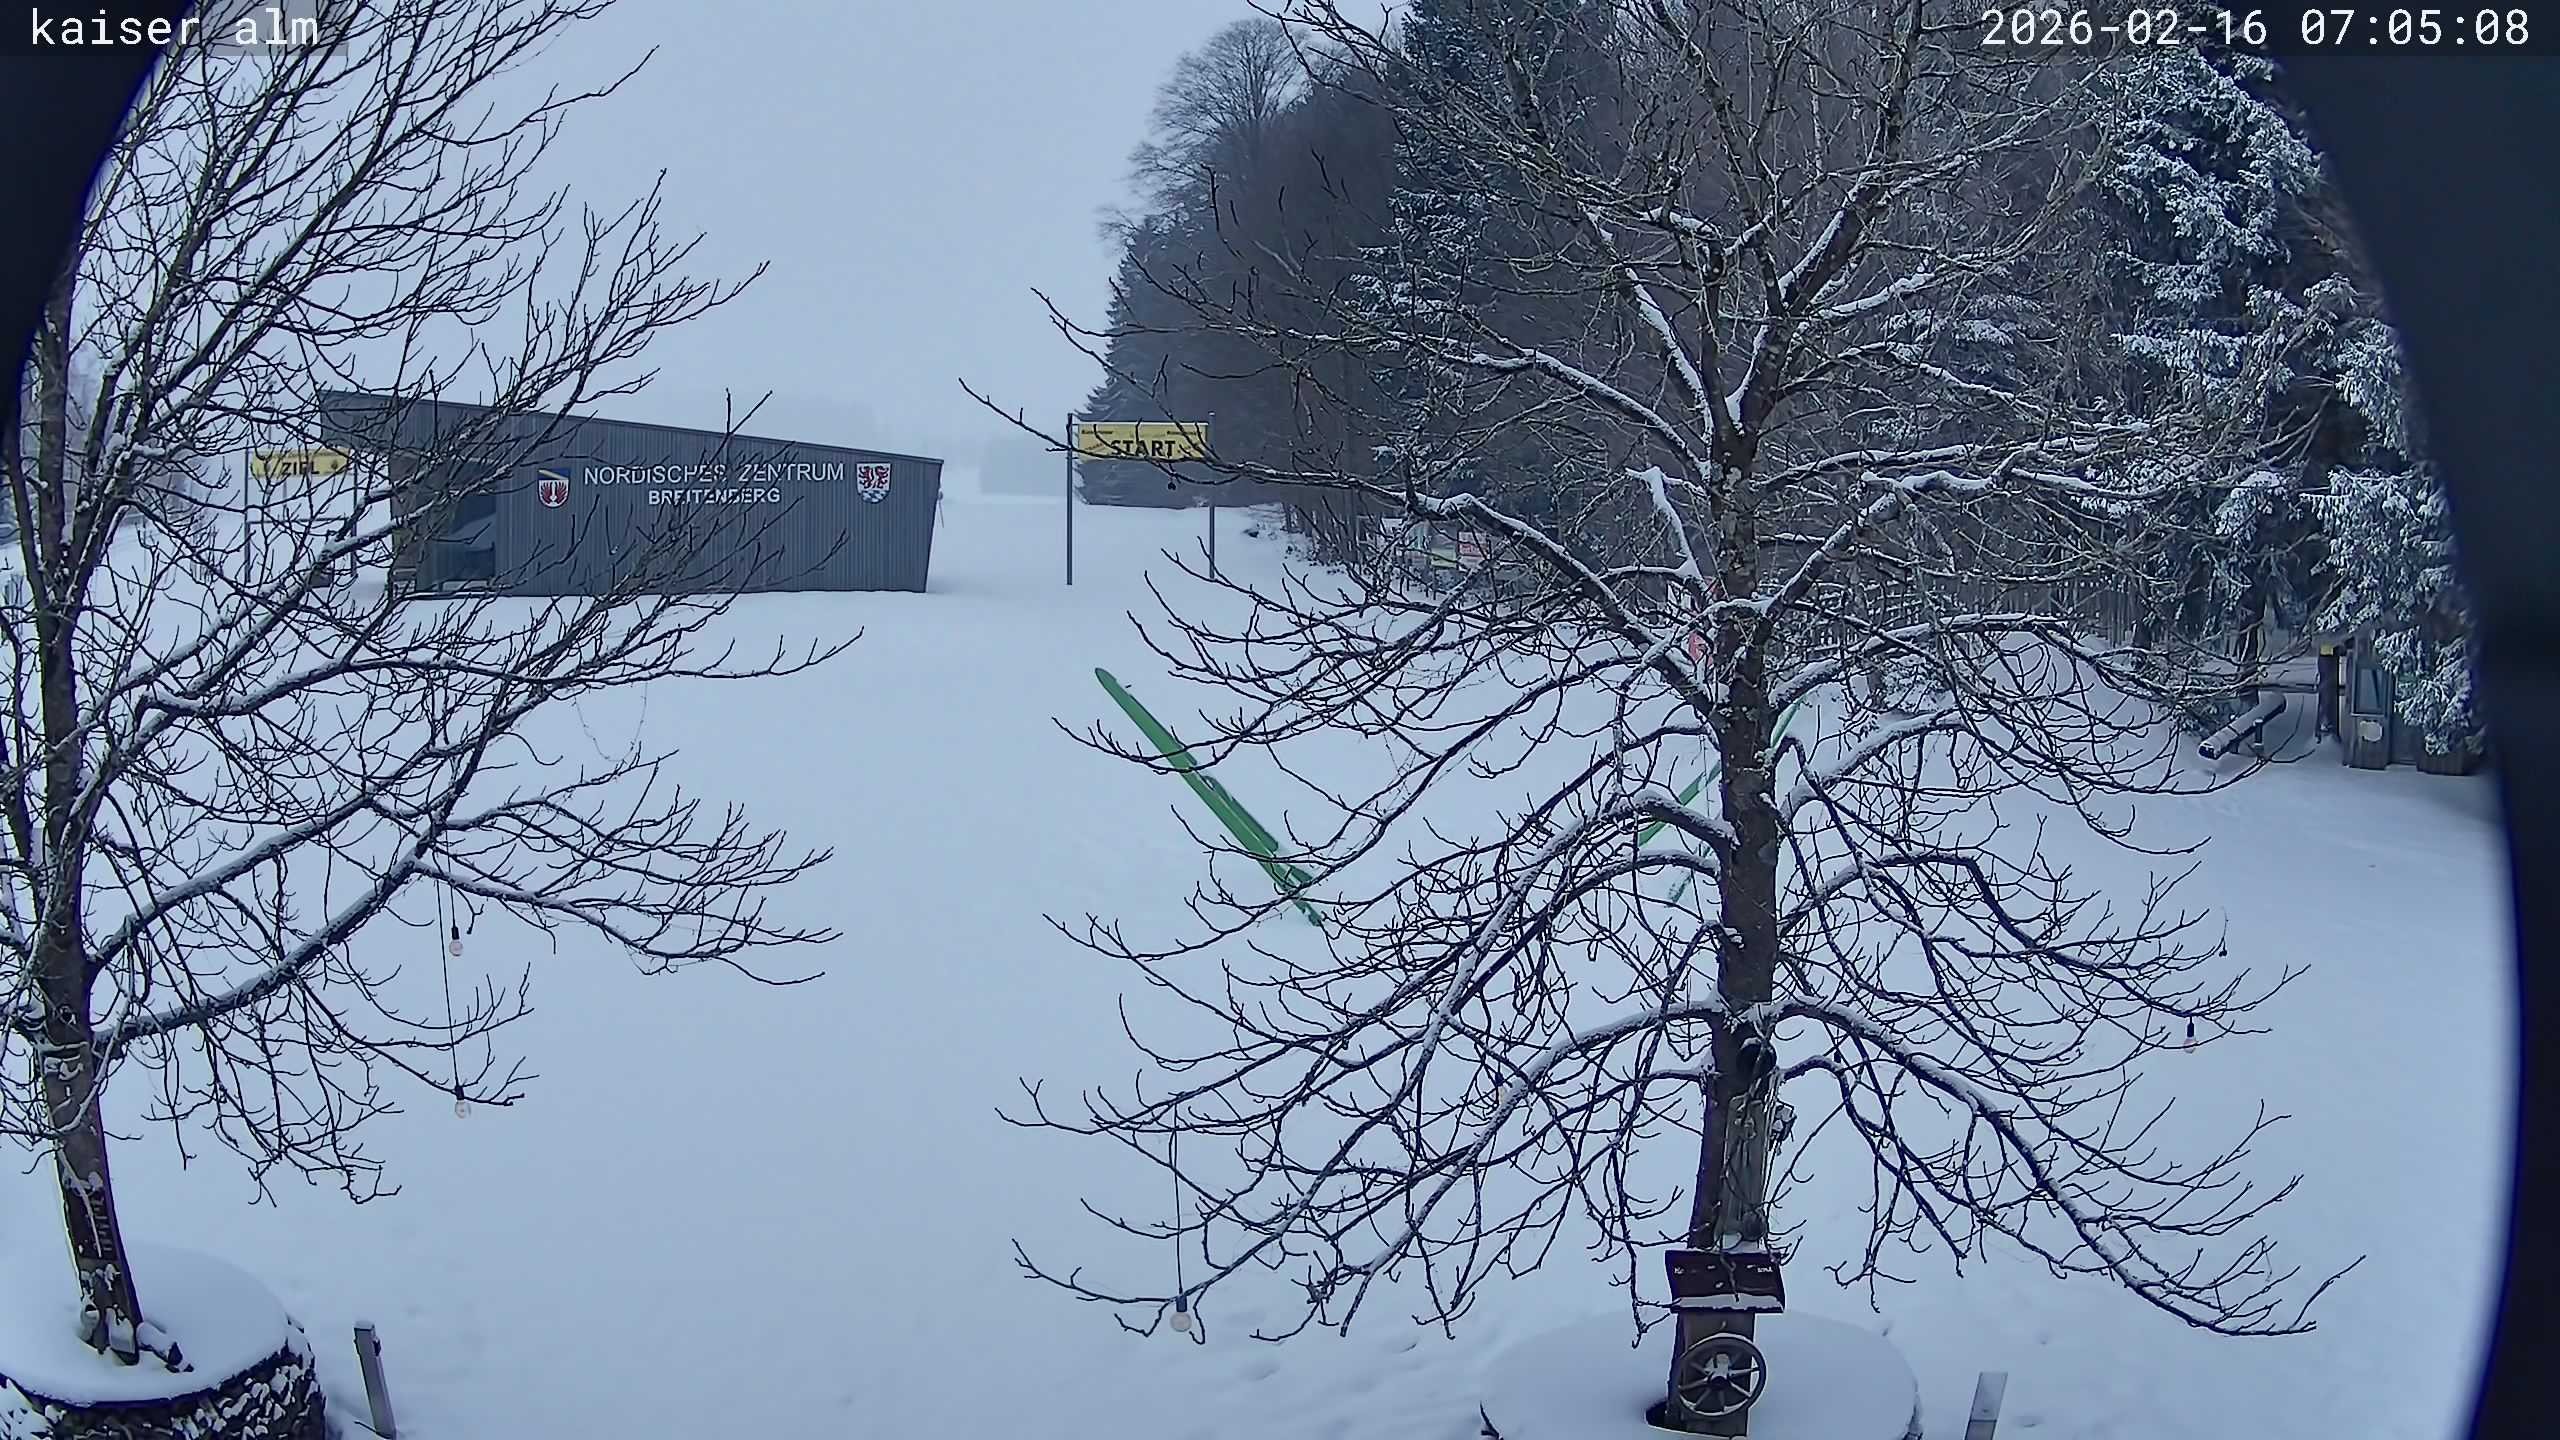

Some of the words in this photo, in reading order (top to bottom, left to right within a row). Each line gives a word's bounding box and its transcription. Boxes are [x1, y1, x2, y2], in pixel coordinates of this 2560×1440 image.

[1111, 440, 1176, 457] START
[281, 462, 319, 475] ZIEL
[584, 464, 727, 485] NORDISCHES
[738, 462, 845, 482] ZENTRUM
[648, 487, 781, 505] BREITENBERG
